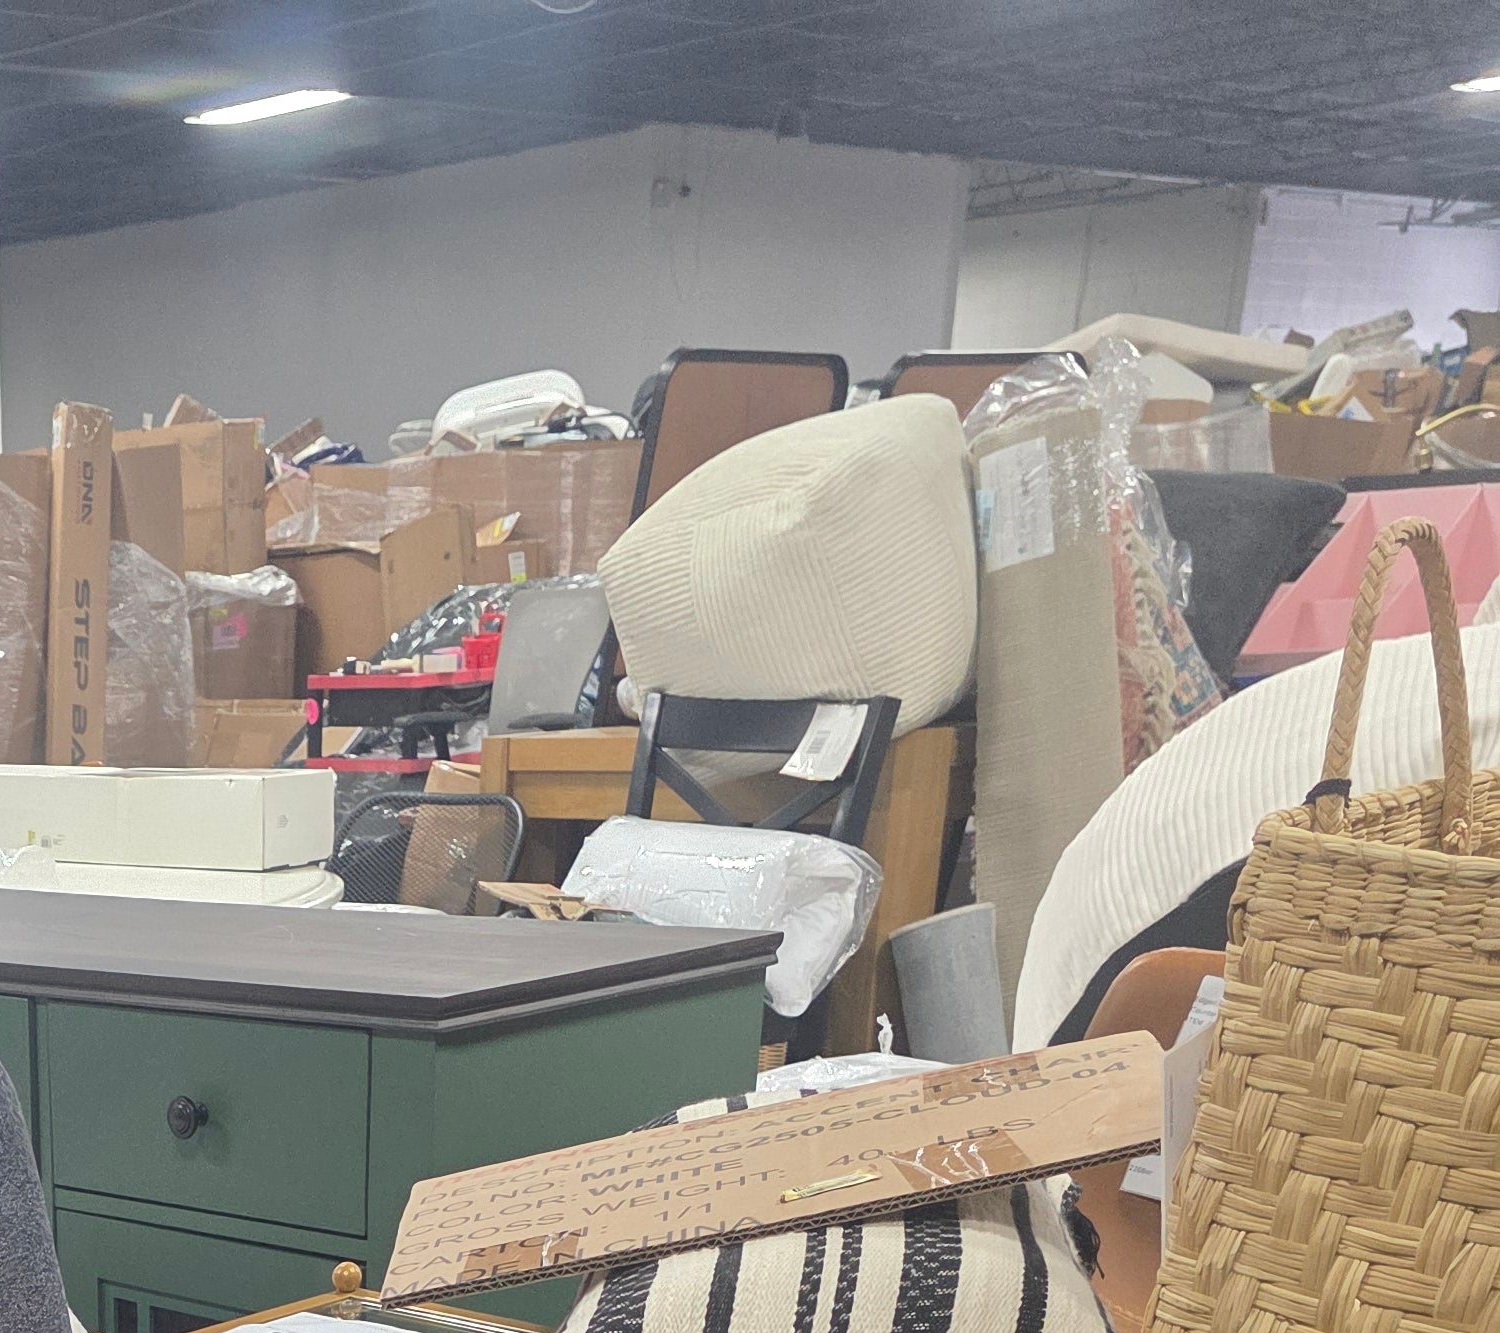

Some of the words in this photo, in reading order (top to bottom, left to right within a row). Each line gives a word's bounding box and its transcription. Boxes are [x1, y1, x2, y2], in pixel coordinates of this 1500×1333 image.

[74, 578, 91, 691] STEP
[397, 1213, 565, 1256] GROSS
[582, 1168, 786, 1216] WEIGHT:
[937, 1118, 1036, 1146] LBS
[405, 1194, 577, 1237] COLOR:
[588, 1157, 743, 1197] WHITE
[412, 1200, 473, 1221] PO
[490, 1182, 565, 1202] NO:
[581, 1060, 1131, 1183] MF#CG2505-CLOUD-04
[420, 1129, 737, 1205] DESCRIPTION:
[752, 1081, 953, 1131] ACCENT
[381, 1260, 520, 1298] MADE
[603, 1216, 767, 1253] CHINA
[653, 1202, 711, 1222] 1/1
